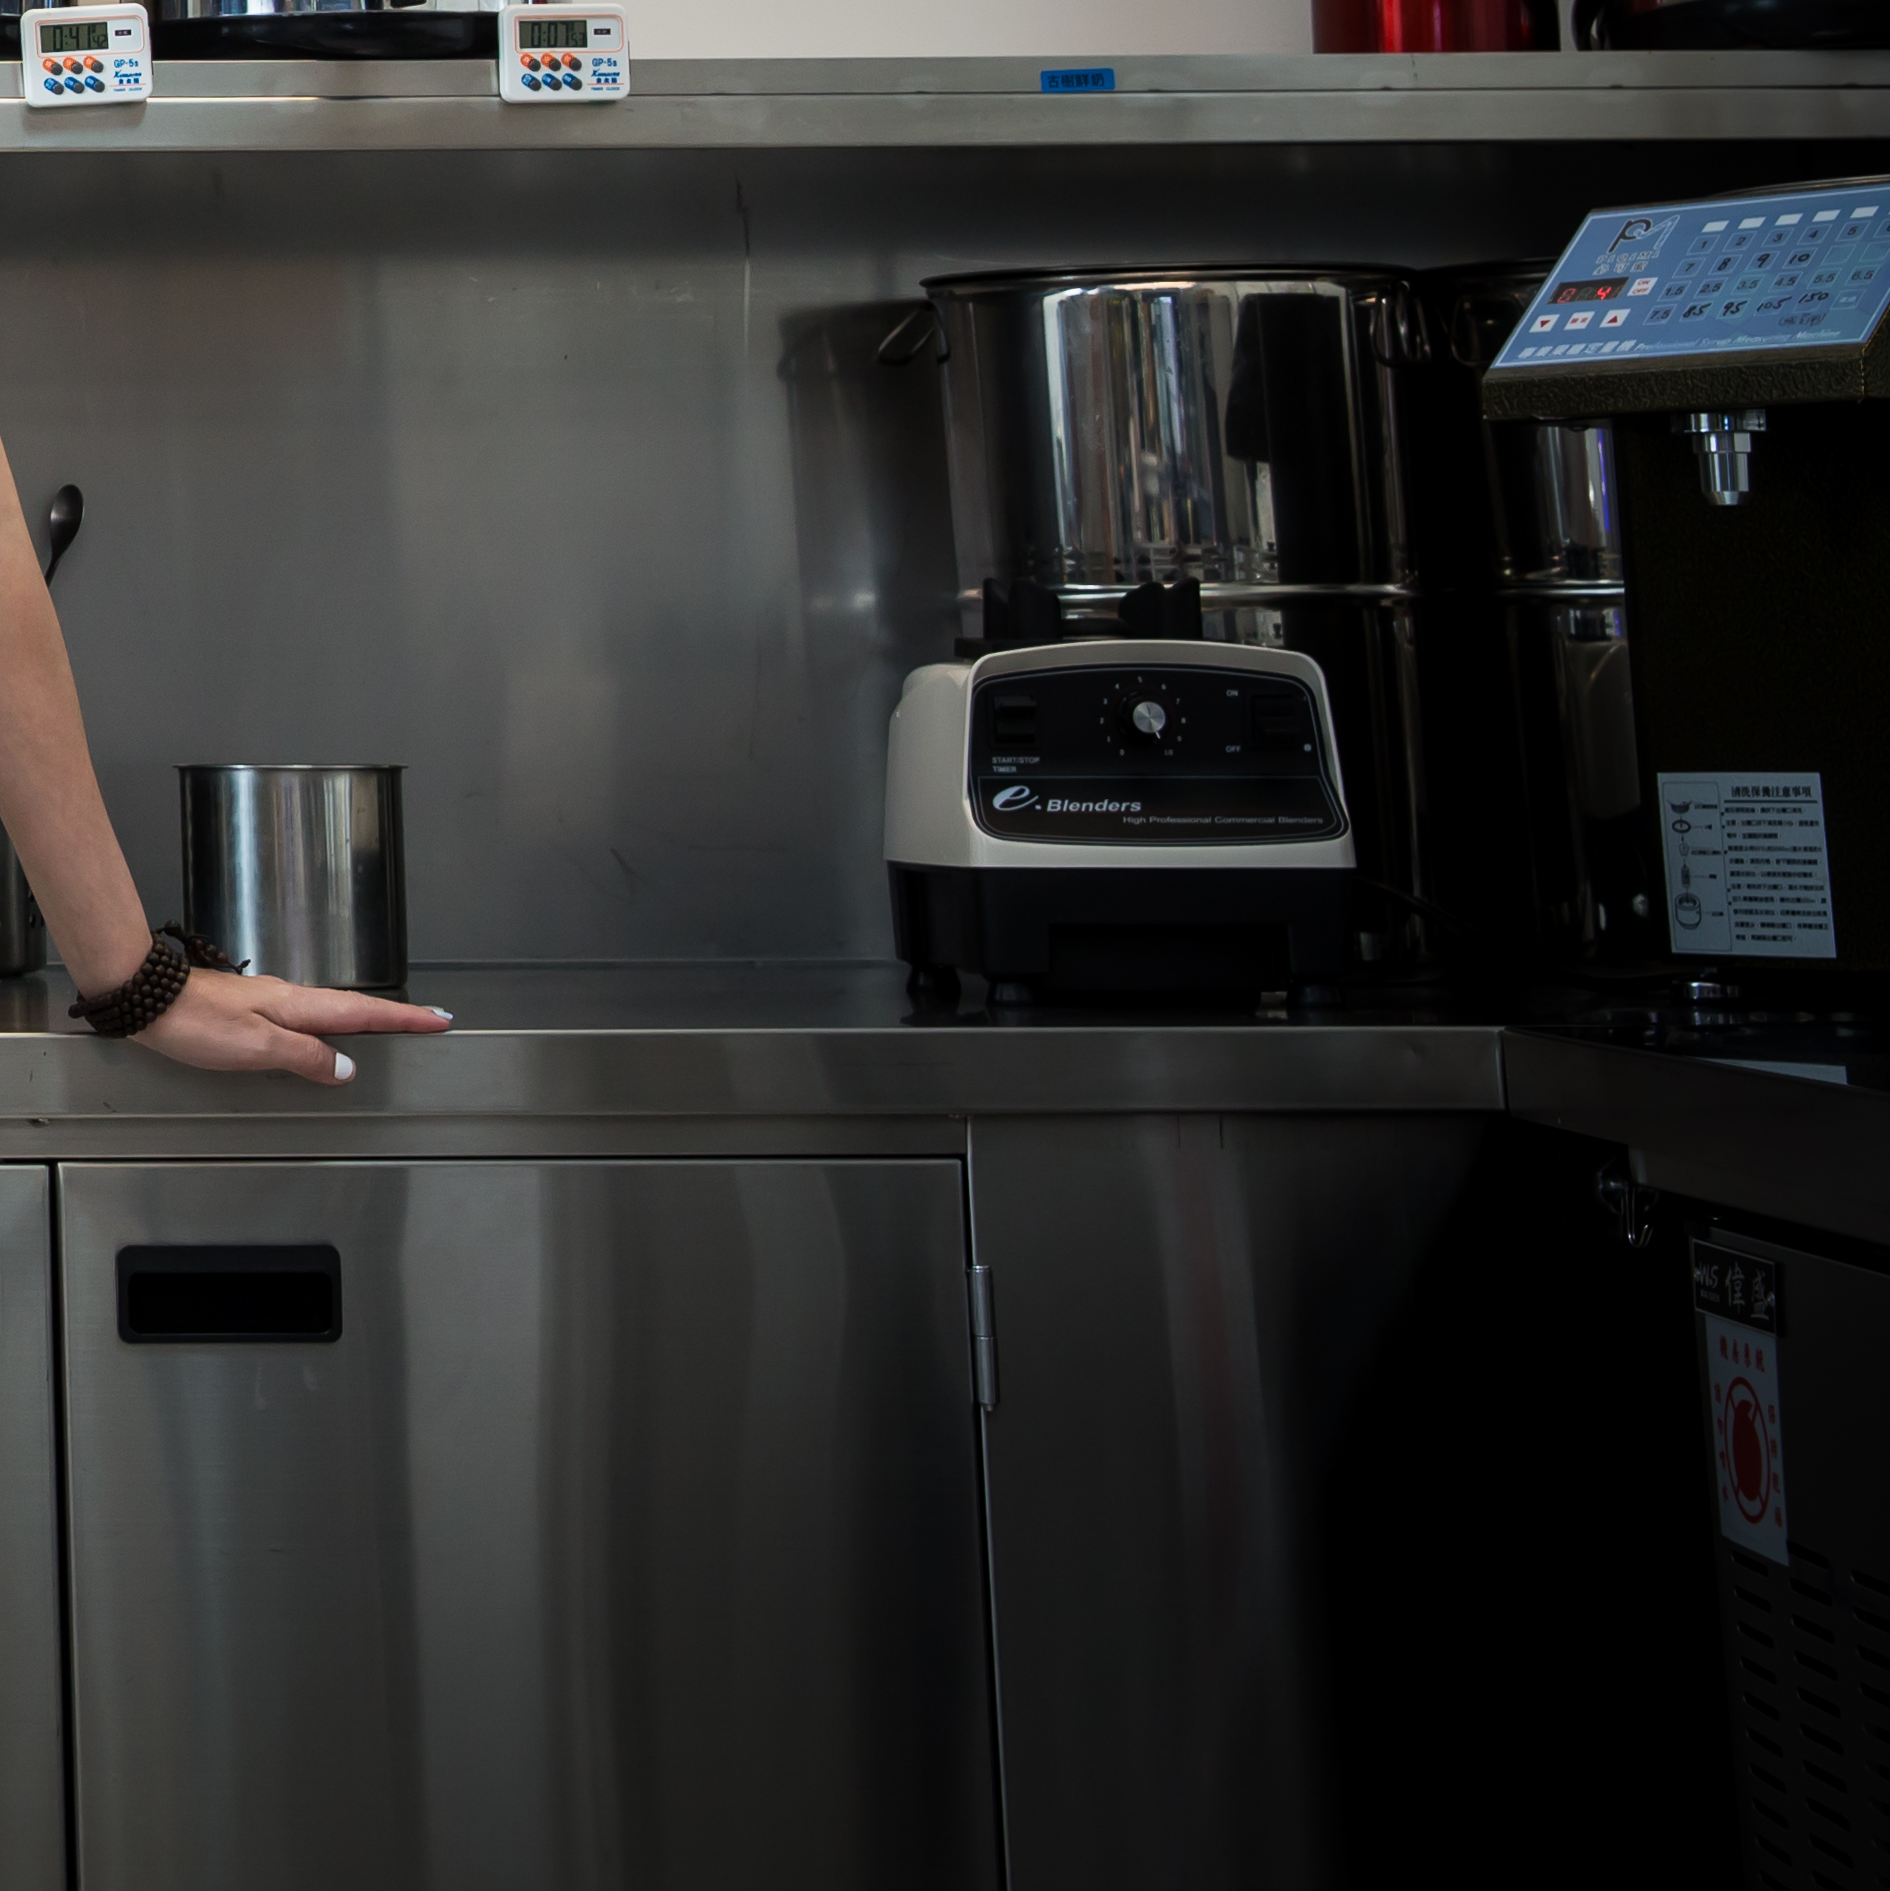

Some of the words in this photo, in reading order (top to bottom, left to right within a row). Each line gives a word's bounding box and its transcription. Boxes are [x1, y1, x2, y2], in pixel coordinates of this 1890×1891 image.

[1735, 236, 1746, 246] 2
[1772, 233, 1783, 243] 3
[1809, 229, 1819, 239] 4
[1847, 225, 1857, 236] 5
[1788, 253, 1811, 265] 10
[1685, 263, 1694, 273] 7
[1665, 285, 1684, 297] 1.5
[1697, 282, 1721, 294] 2.5
[1737, 279, 1760, 290] 3.5
[1774, 275, 1797, 287] 4.5
[1813, 272, 1835, 283] 5.5
[1851, 270, 1874, 280] 6.5
[1650, 309, 1671, 320] 7.5
[1793, 328, 1841, 341] Machine
[1226, 689, 1239, 697] ON
[1225, 745, 1241, 753] OFF
[992, 756, 1040, 764] START/STOP
[1122, 816, 1147, 825] High
[1148, 816, 1212, 824] Professional
[1214, 816, 1275, 824] Commercial
[1277, 816, 1324, 825] Blenders
